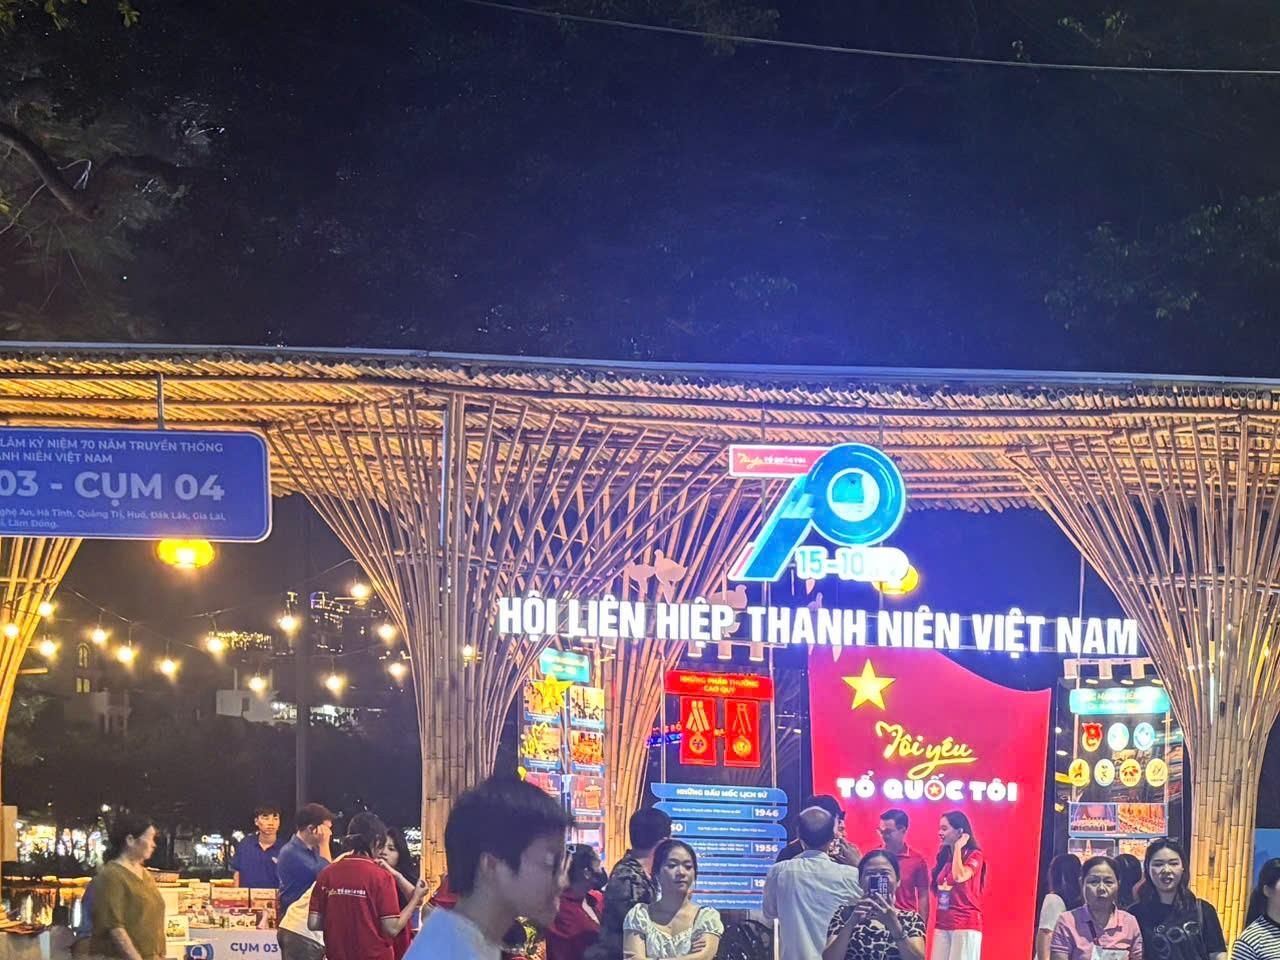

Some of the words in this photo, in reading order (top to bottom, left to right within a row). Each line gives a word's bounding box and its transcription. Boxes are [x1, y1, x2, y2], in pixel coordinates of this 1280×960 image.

[81, 440, 96, 449] 70
[0, 452, 20, 461] NH
[23, 450, 52, 462] NIÊN
[55, 451, 82, 464] VIỆT
[84, 453, 113, 463] NAM
[74, 471, 162, 507] CỤM
[174, 473, 225, 501] 04
[499, 590, 557, 642] HỘI
[568, 595, 646, 640] LIÊN
[656, 596, 736, 647] HIỆP
[747, 606, 866, 647] THANH
[877, 605, 960, 650] NIÊN
[972, 607, 1046, 658] VIỆT
[1056, 617, 1138, 656] NAM
[837, 770, 875, 798] TỔ
[883, 774, 965, 800] QUỐC
[969, 778, 1018, 801] TÔI
[754, 808, 780, 818] 1946
[754, 843, 779, 853] 1956
[230, 942, 260, 955] CỤM
[263, 943, 279, 953] 03
